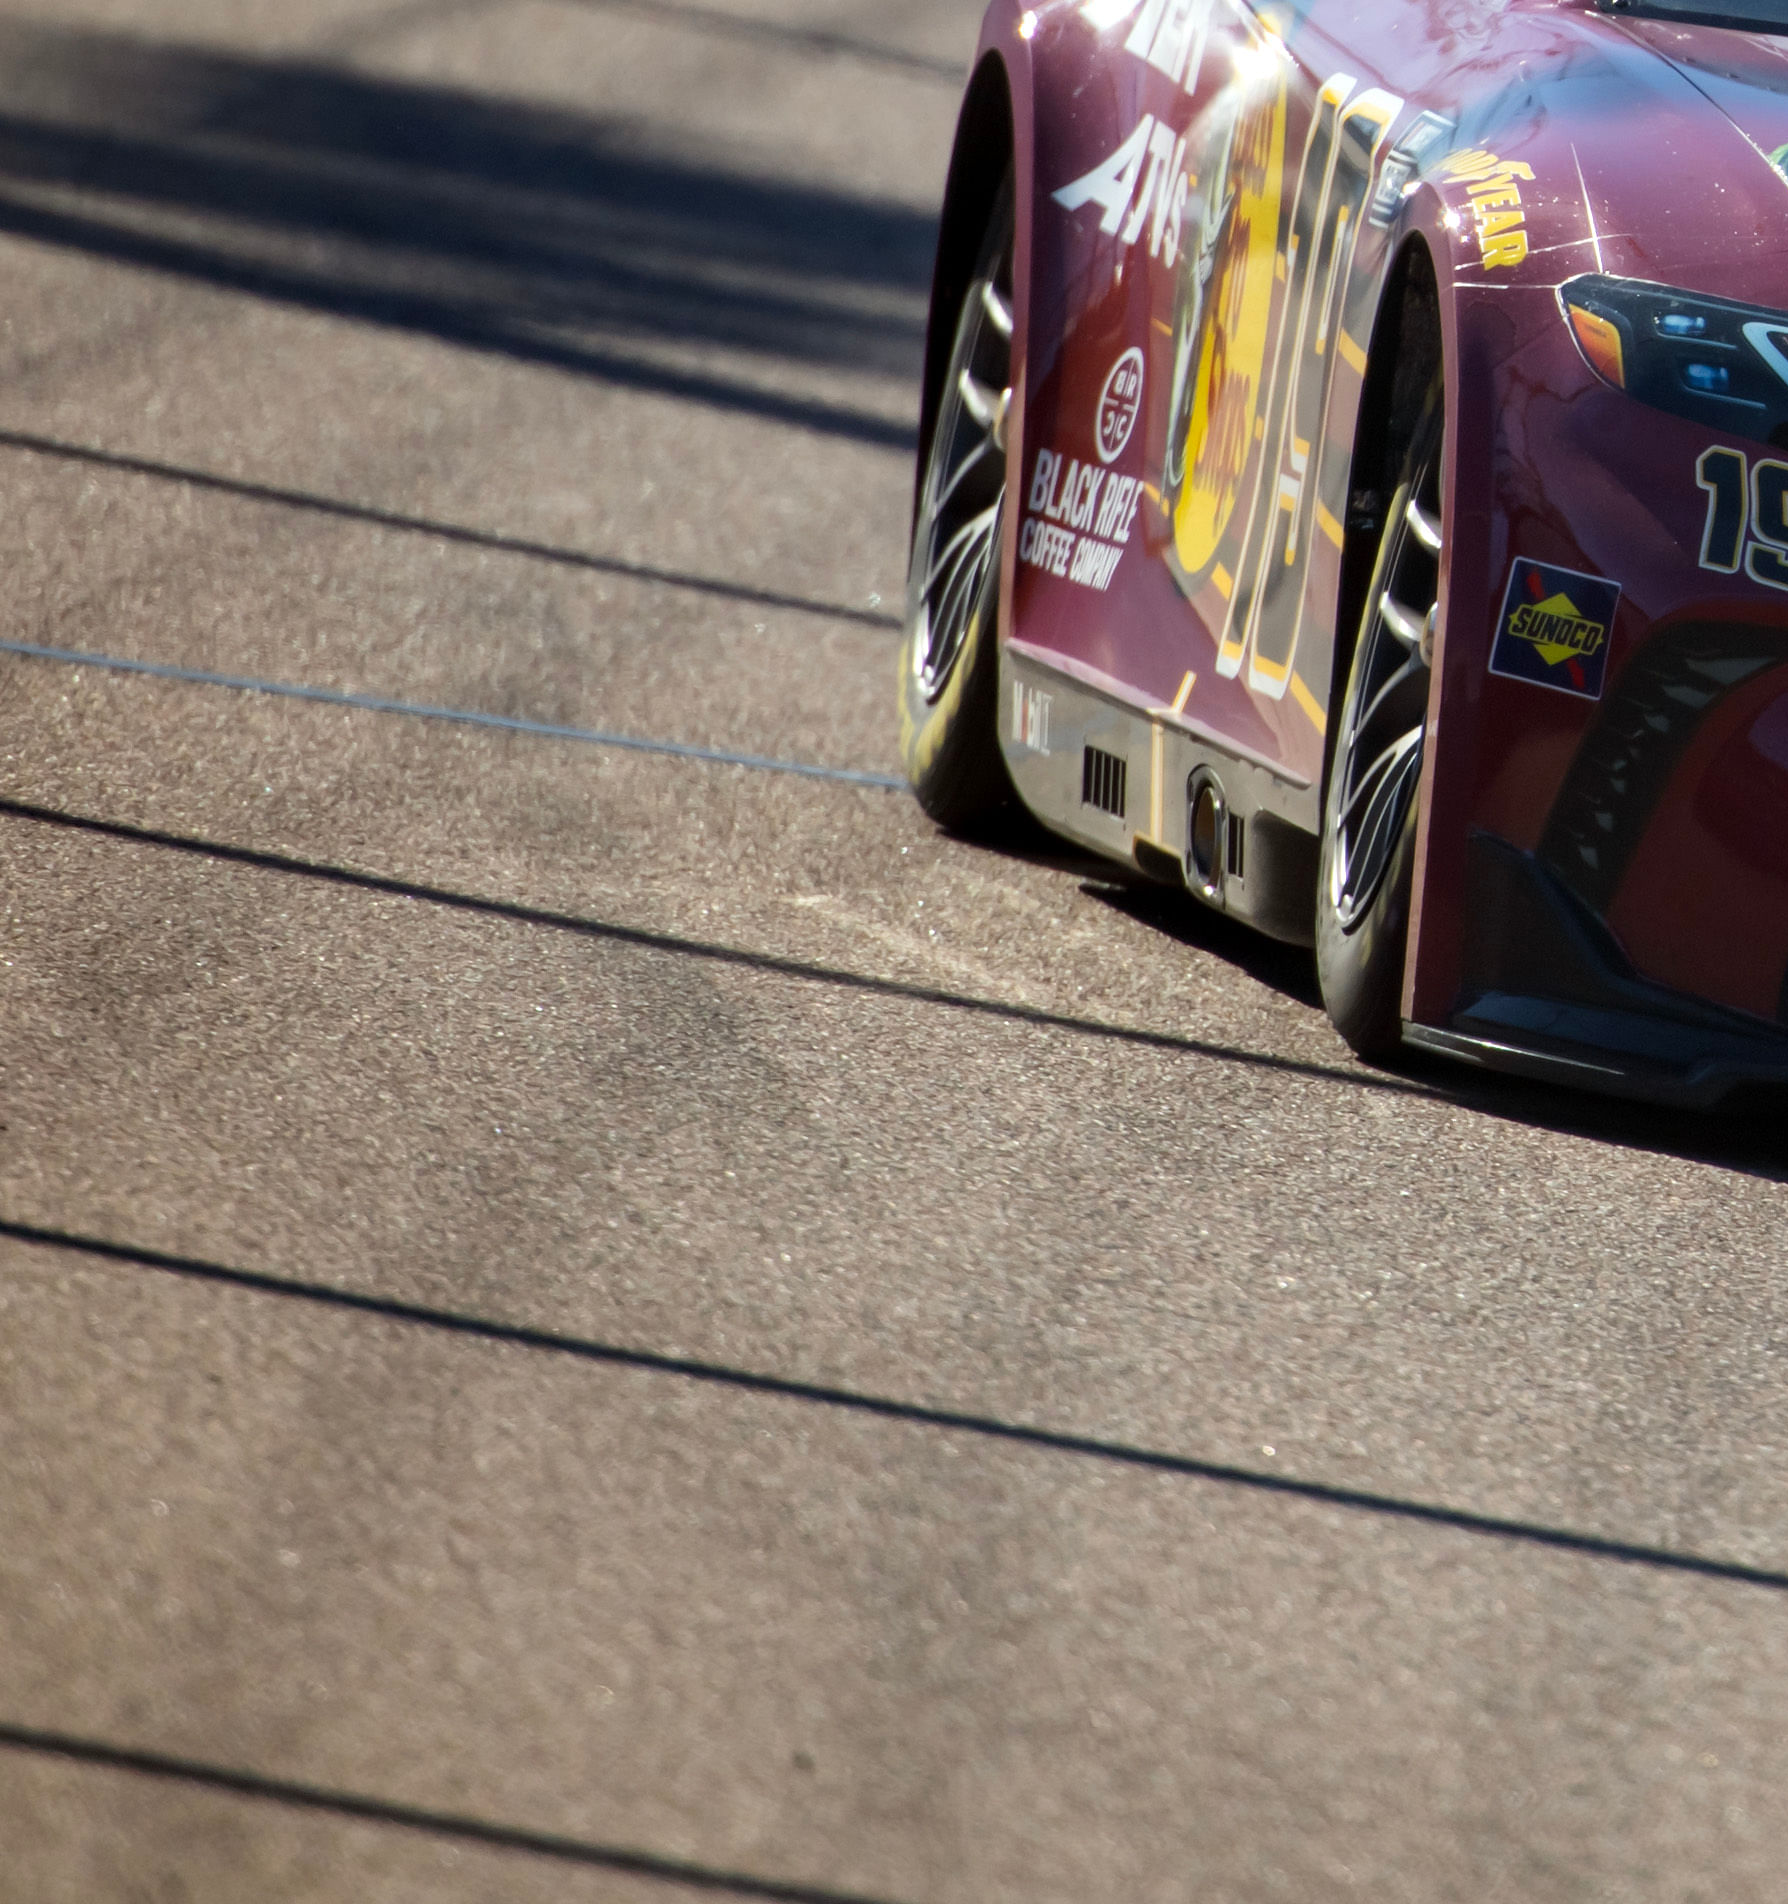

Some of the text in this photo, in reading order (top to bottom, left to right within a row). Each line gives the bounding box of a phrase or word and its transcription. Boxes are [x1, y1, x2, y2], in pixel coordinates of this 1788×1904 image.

[1028, 447, 1145, 544] BLACK RIFLE
[1020, 516, 1125, 592] COFFEE COMPANY
[1511, 606, 1602, 655] SUNOCO
